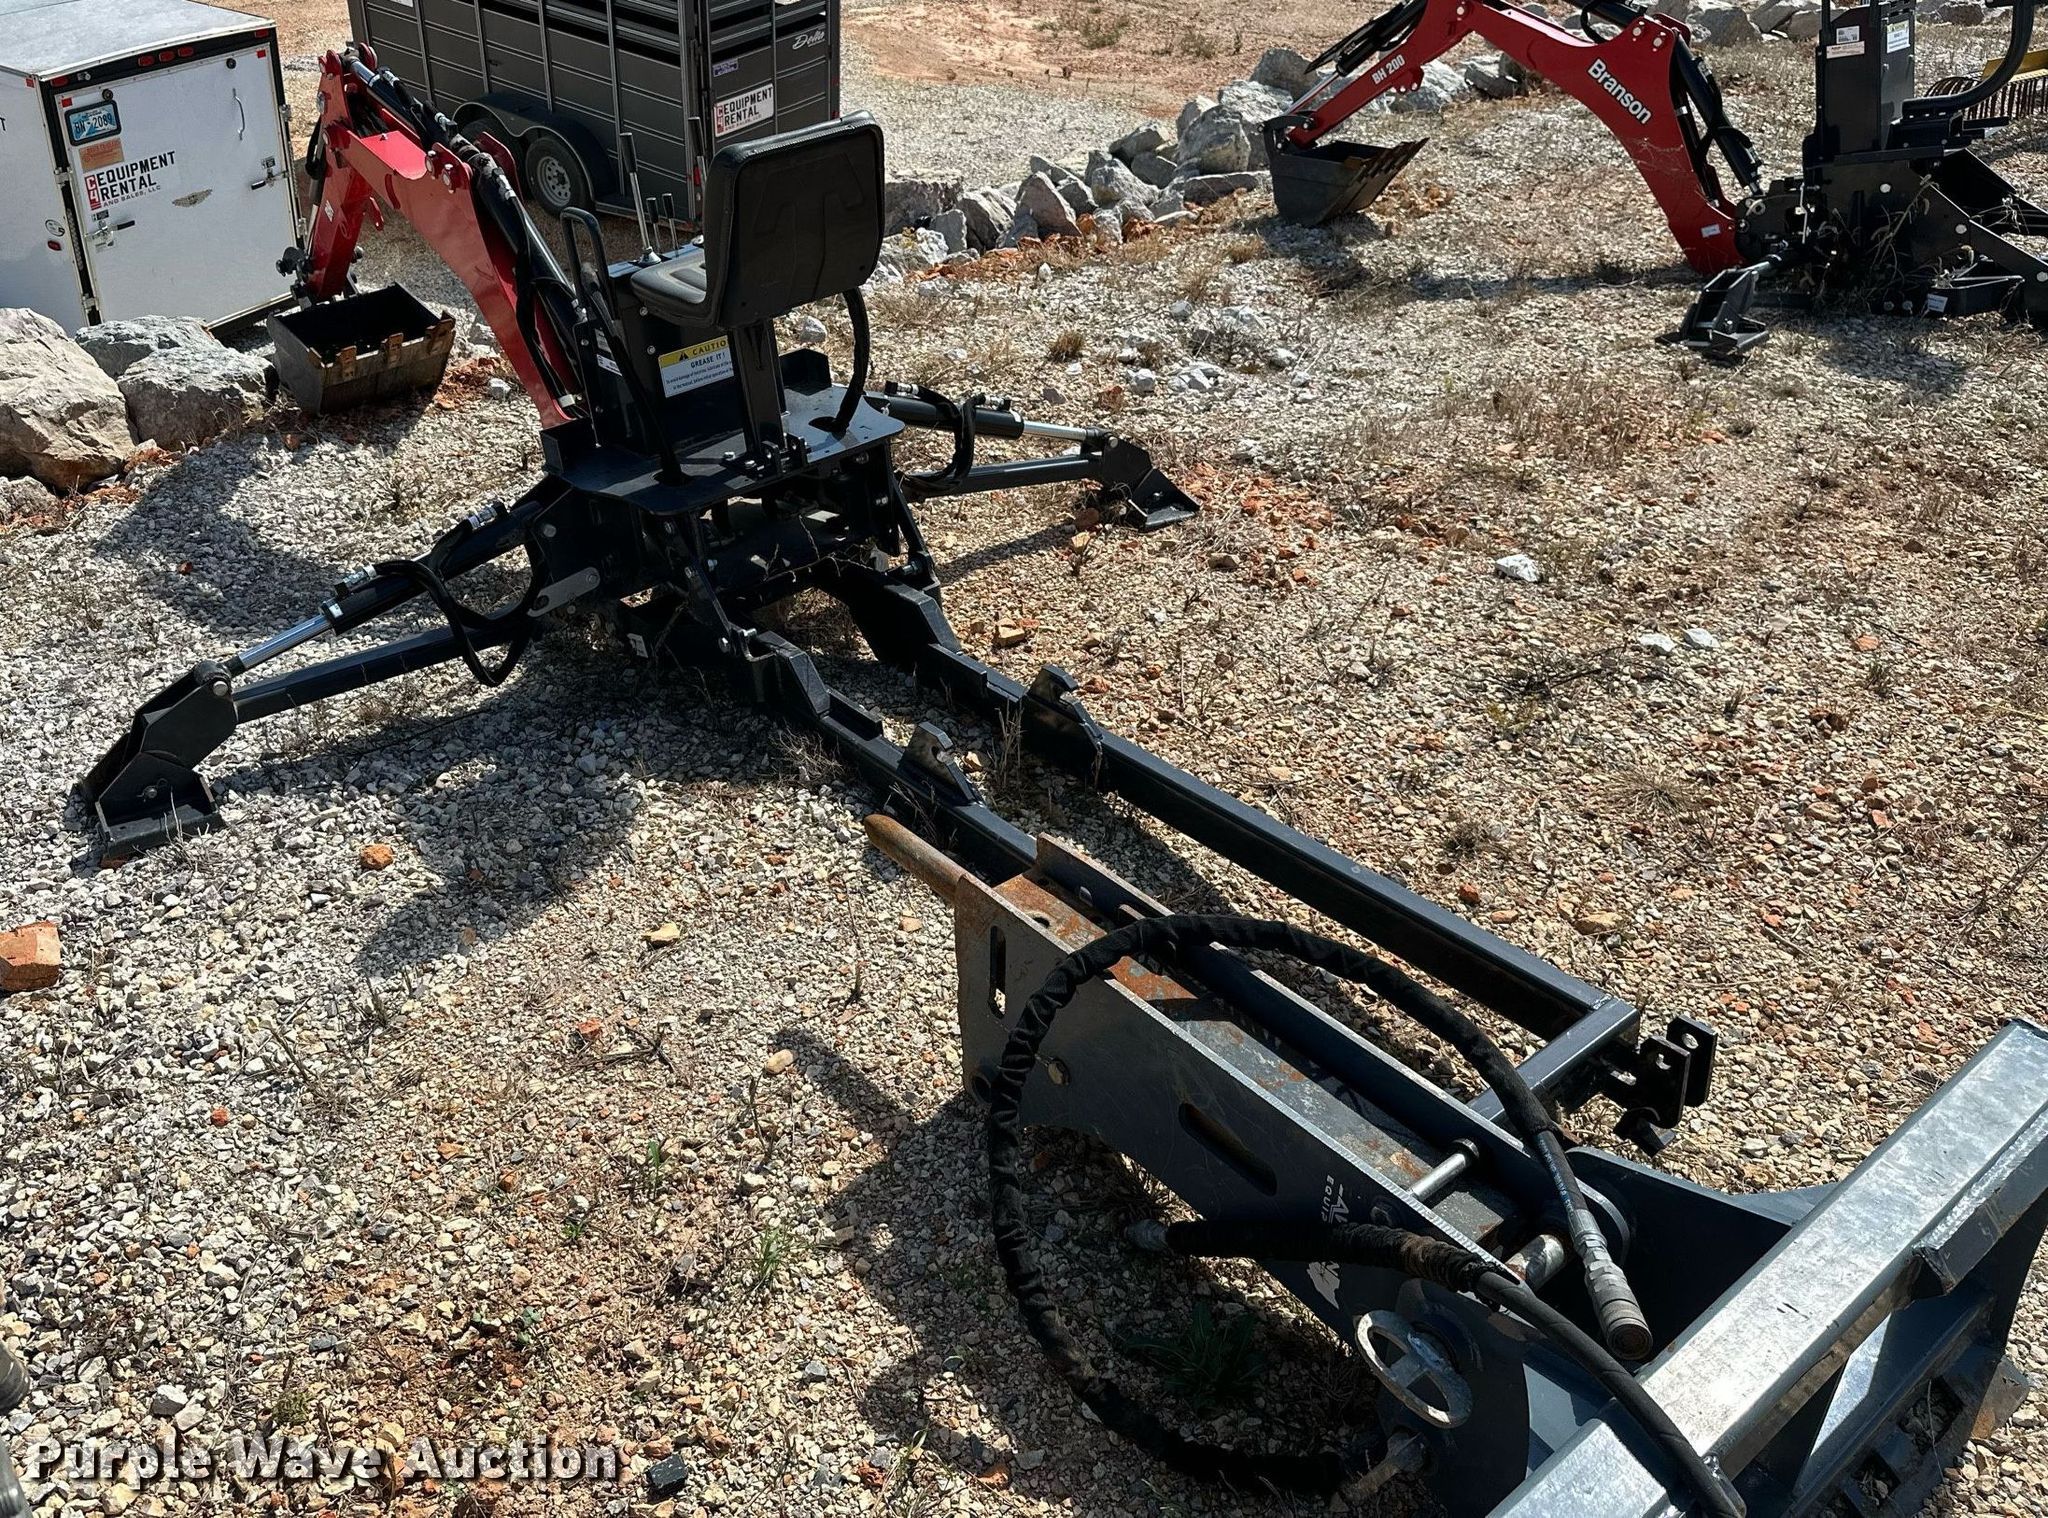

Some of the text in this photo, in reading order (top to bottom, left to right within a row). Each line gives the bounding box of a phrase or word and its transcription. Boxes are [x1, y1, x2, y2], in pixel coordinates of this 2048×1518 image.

[1371, 54, 1405, 84] BH 200
[724, 87, 773, 115] EQUIPMENT
[1586, 58, 1652, 125] Branson
[724, 106, 759, 127] RENTAL
[96, 151, 175, 187] EQUIPMENT
[100, 174, 157, 202] RENTAL
[103, 198, 119, 207] AND
[148, 185, 161, 193] LLC
[691, 356, 714, 369] GREASE
[693, 341, 726, 356] CAUTIO
[1320, 1174, 1335, 1223] EQUIP
